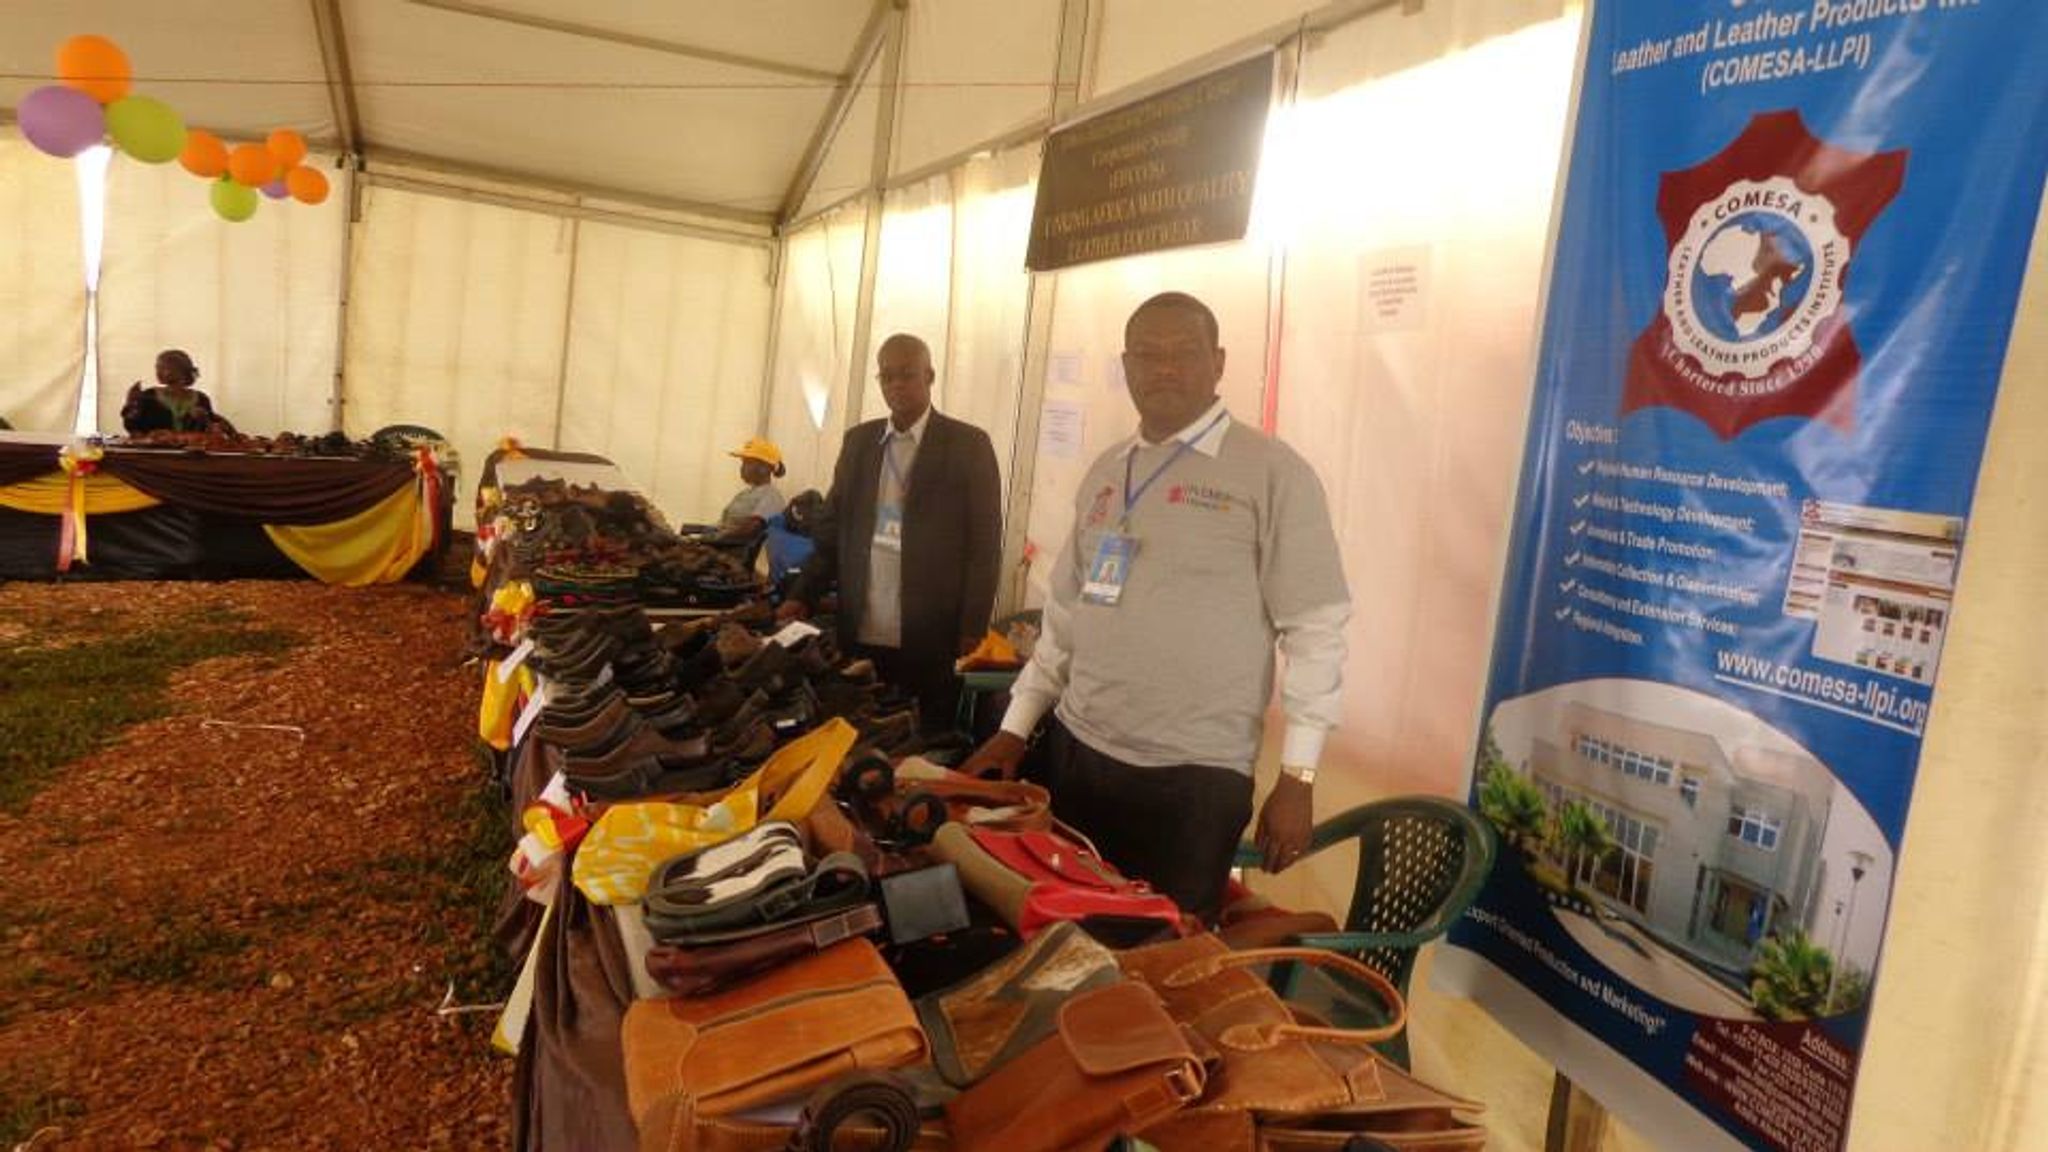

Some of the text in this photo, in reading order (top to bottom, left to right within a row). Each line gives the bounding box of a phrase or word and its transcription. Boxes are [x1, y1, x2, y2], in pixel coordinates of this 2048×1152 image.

[1611, 38, 1671, 74] Leather
[1673, 20, 1710, 58] and
[1713, 12, 1804, 49] Leather
[1702, 34, 1871, 94] (COMESA-LLPI)
[1714, 190, 1803, 220] COMESA
[1742, 318, 1811, 364] PRODUCTS
[1740, 372, 1790, 395] Since
[1666, 573, 1674, 588] &
[1580, 974, 1601, 997] and
